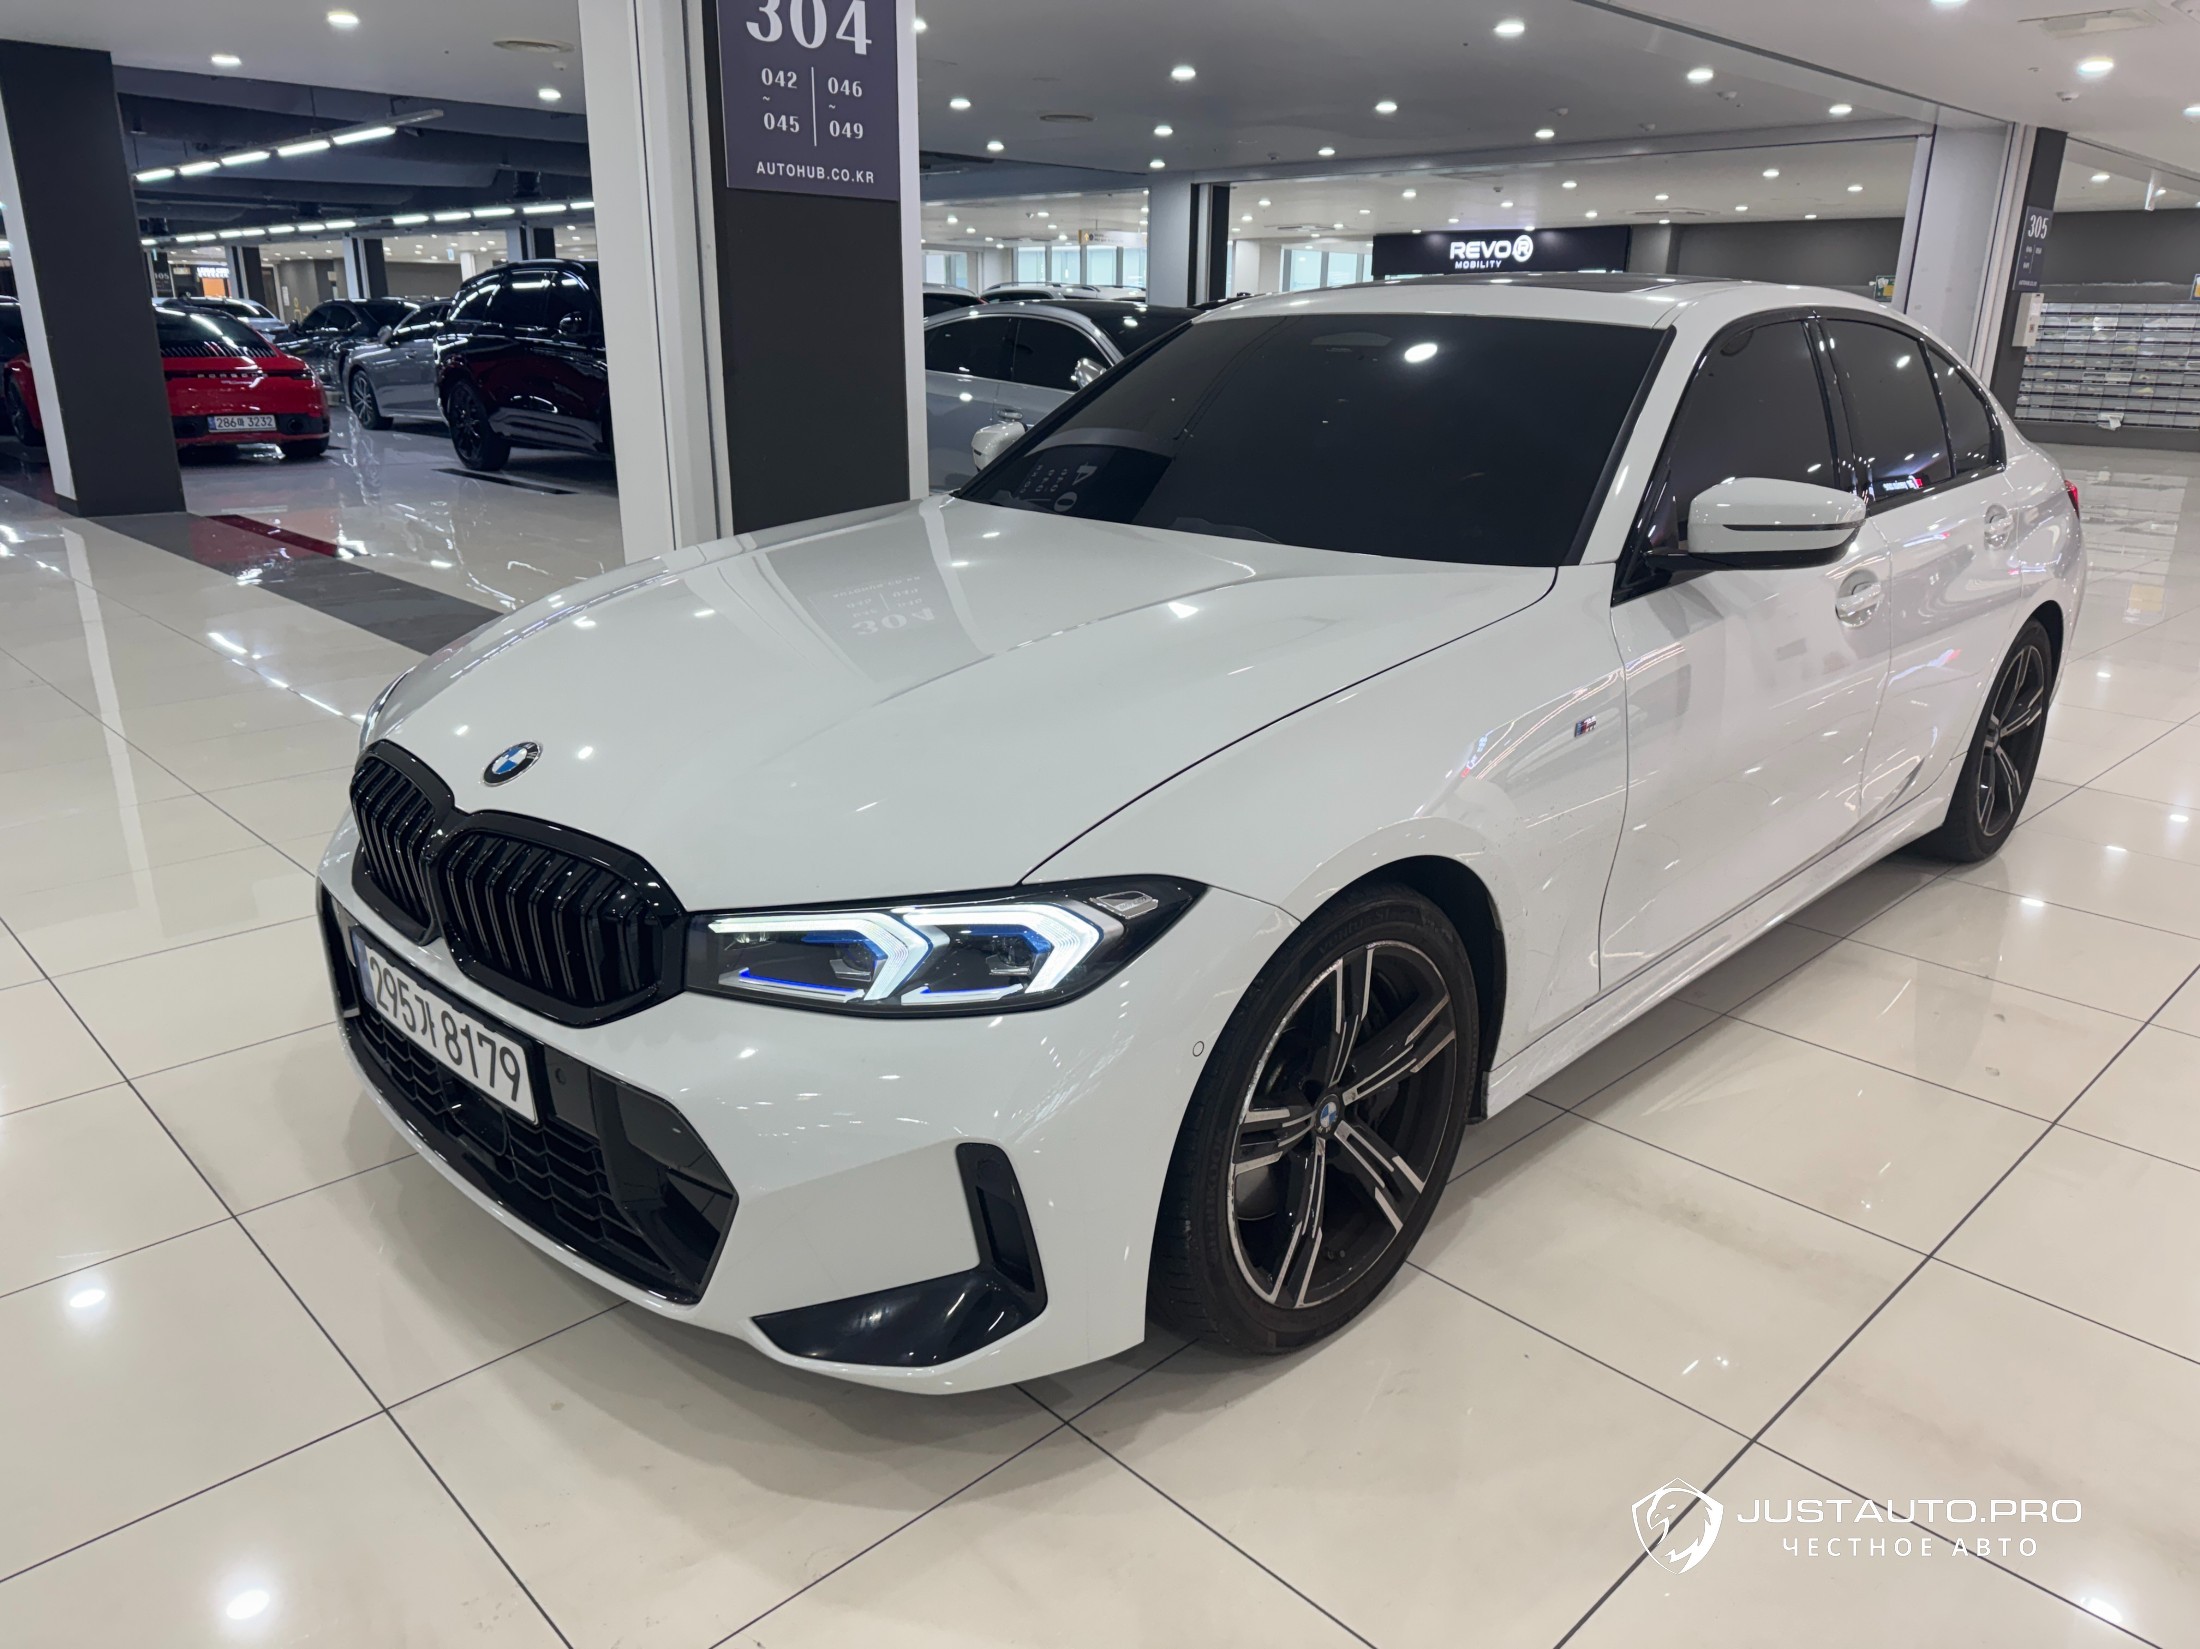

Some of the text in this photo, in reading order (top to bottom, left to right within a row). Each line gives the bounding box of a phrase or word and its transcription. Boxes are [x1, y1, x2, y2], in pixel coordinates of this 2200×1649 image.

[746, 0, 872, 55] 304
[761, 68, 797, 89] 042
[827, 77, 863, 97] 046
[763, 113, 800, 133] 045
[829, 120, 864, 139] 049
[756, 161, 875, 184] AUTOHUB.CO.KR
[2027, 214, 2049, 239] 305
[1454, 260, 1502, 269] MOBILITY
[247, 416, 273, 427] 3232
[369, 956, 520, 1102] 295가 8179
